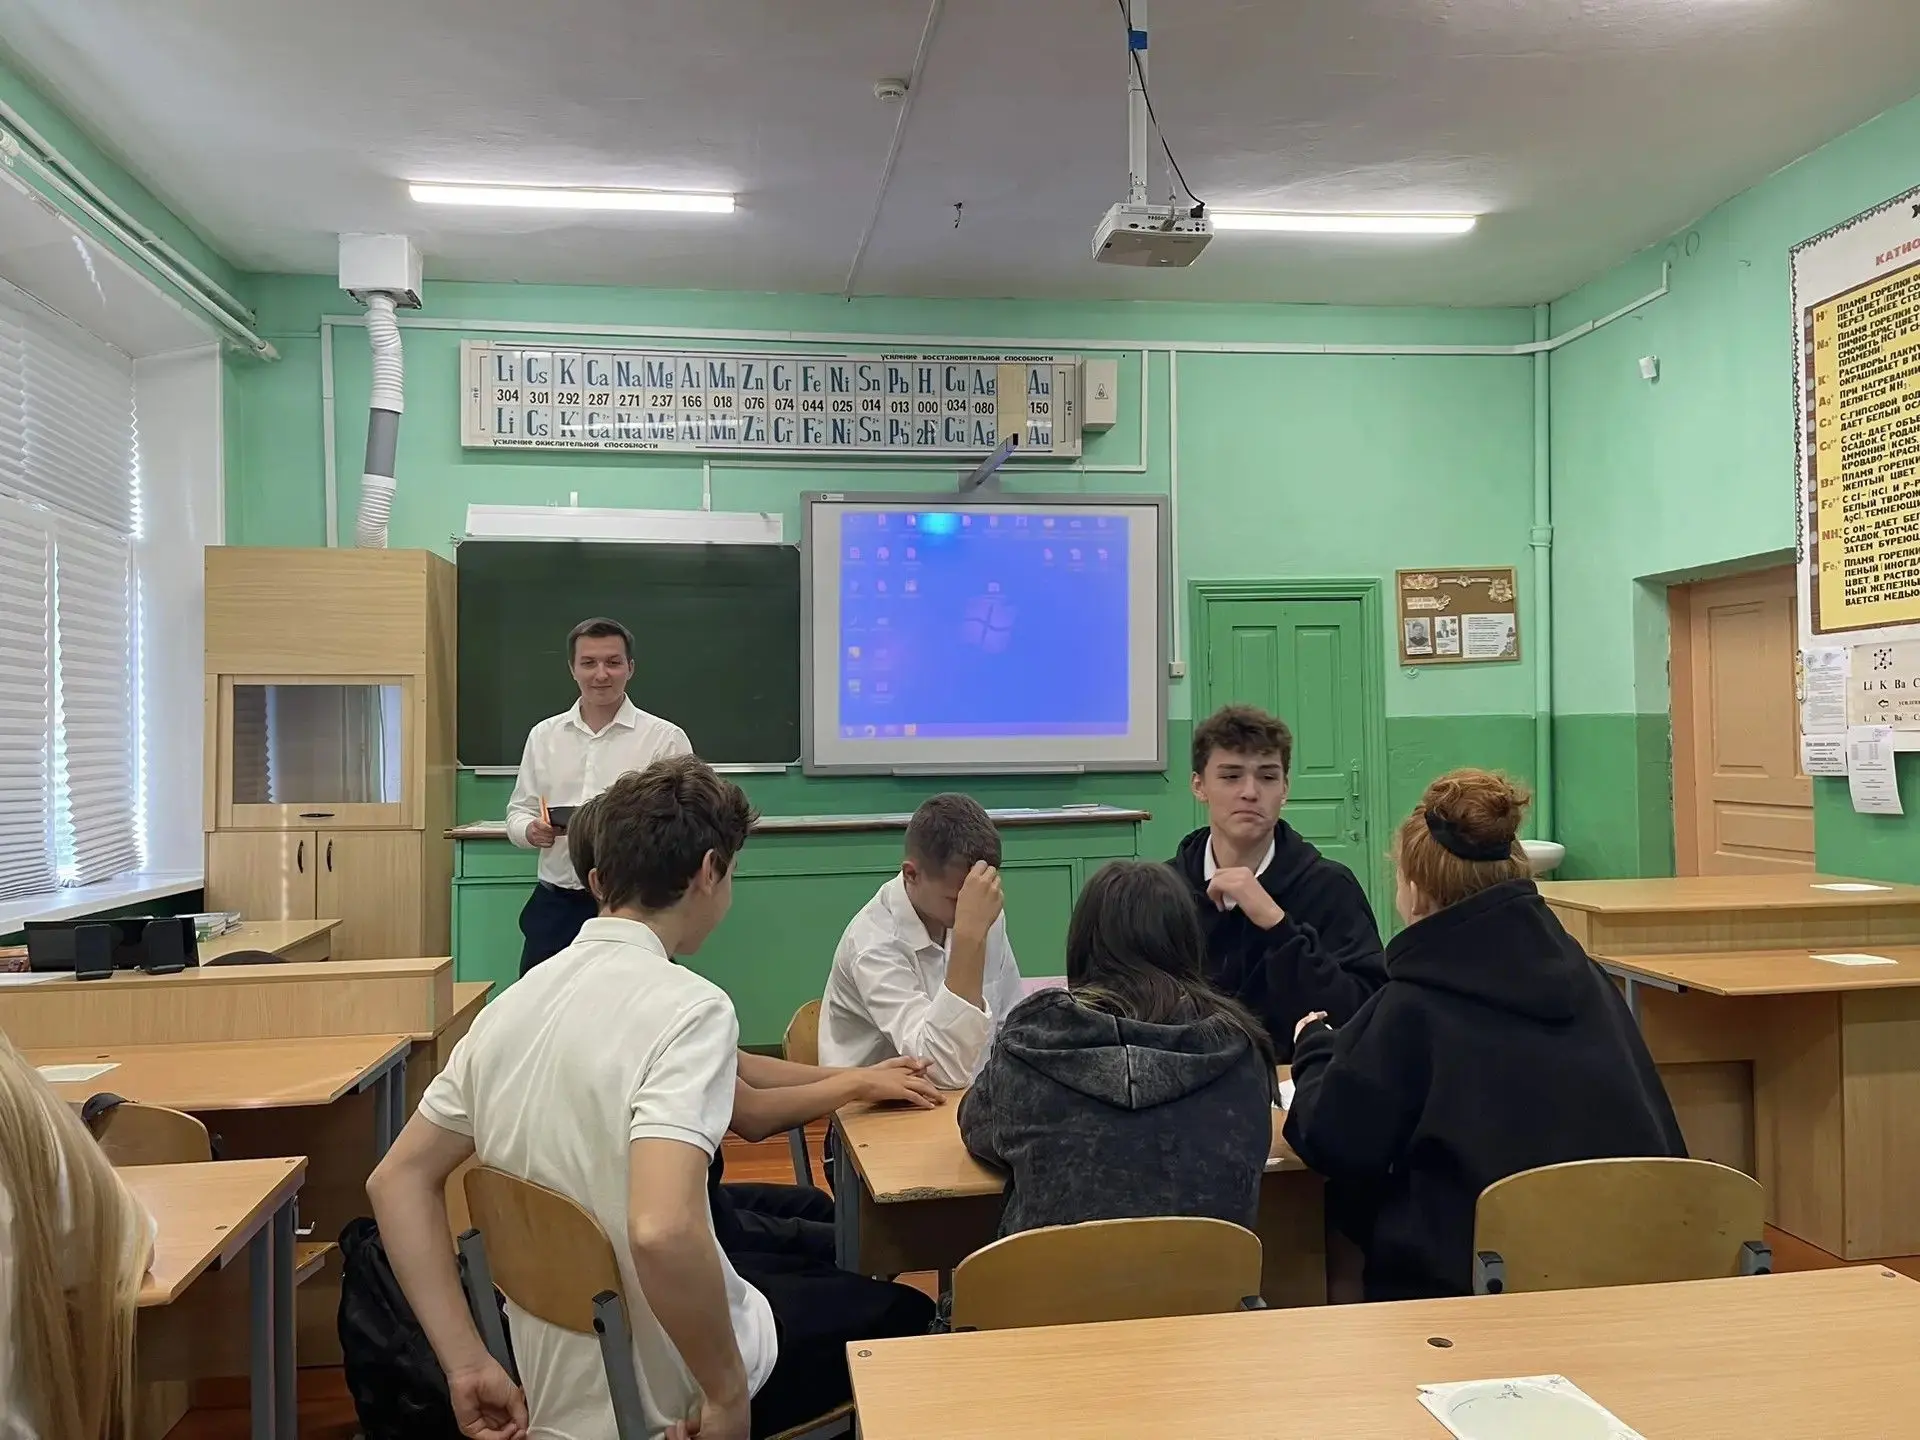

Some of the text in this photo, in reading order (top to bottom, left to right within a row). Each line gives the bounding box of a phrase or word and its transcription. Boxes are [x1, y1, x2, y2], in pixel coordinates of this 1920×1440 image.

[1838, 314, 1864, 329] ЧЕРЕЗ
[1869, 300, 1898, 317] СИНЕЕ
[1838, 339, 1879, 359] СМОЧИТЬ
[1839, 355, 1886, 378] РАСТВОРЫ
[1840, 360, 1898, 386] ОКРАШИВАЕТ
[497, 355, 513, 381] Li
[527, 358, 547, 384] Cs
[560, 358, 575, 384] K
[587, 360, 609, 386] Ca
[617, 361, 642, 387] Na
[647, 362, 673, 389] Mg
[681, 362, 701, 388] Al
[709, 362, 735, 388] Mn
[742, 364, 764, 390] Zn
[773, 365, 792, 391] Cr
[802, 366, 821, 392] Fe
[830, 367, 849, 392] Ni
[859, 365, 880, 391] Sn
[888, 368, 908, 393] Pb
[946, 366, 965, 391] Cu
[973, 370, 995, 395] Ag
[1028, 370, 1049, 395] Au
[497, 389, 519, 402] 304
[530, 392, 548, 404] 301
[558, 392, 579, 405] 292
[589, 393, 610, 405] 287
[619, 395, 639, 406] 271
[652, 395, 673, 407] 237
[683, 396, 702, 408] 166
[714, 396, 732, 408] 018
[745, 398, 764, 409] 076
[775, 398, 794, 411] 074
[802, 400, 824, 412] 044
[832, 400, 852, 412] 025
[862, 399, 881, 411] 014
[891, 401, 909, 413] 013
[918, 402, 938, 413] 000
[1840, 387, 1857, 399] ПРИ
[1840, 387, 1886, 409] ДЕЛЯЕТСЯ
[1841, 418, 1862, 431] ДАЕТ
[1867, 406, 1900, 423] БЕЛЫЙ
[1842, 444, 1885, 462] АММОНИЯ
[1842, 468, 1873, 482] ПЛАМЯ
[1843, 475, 1884, 491] ЖЕЛТЫЙ
[1843, 499, 1876, 513] БЕЛЫЙ
[1884, 523, 1919, 536] ТОТЧАС
[1844, 543, 1873, 554] ЗАТЕМ
[1844, 556, 1874, 567] ПЛАМЯ
[1845, 586, 1866, 596] НЫЙ
[1846, 595, 1879, 606] ВАЕТСЯ
[1864, 681, 1872, 690] Li
[1880, 680, 1887, 689] K
[1895, 680, 1905, 689] Ba
